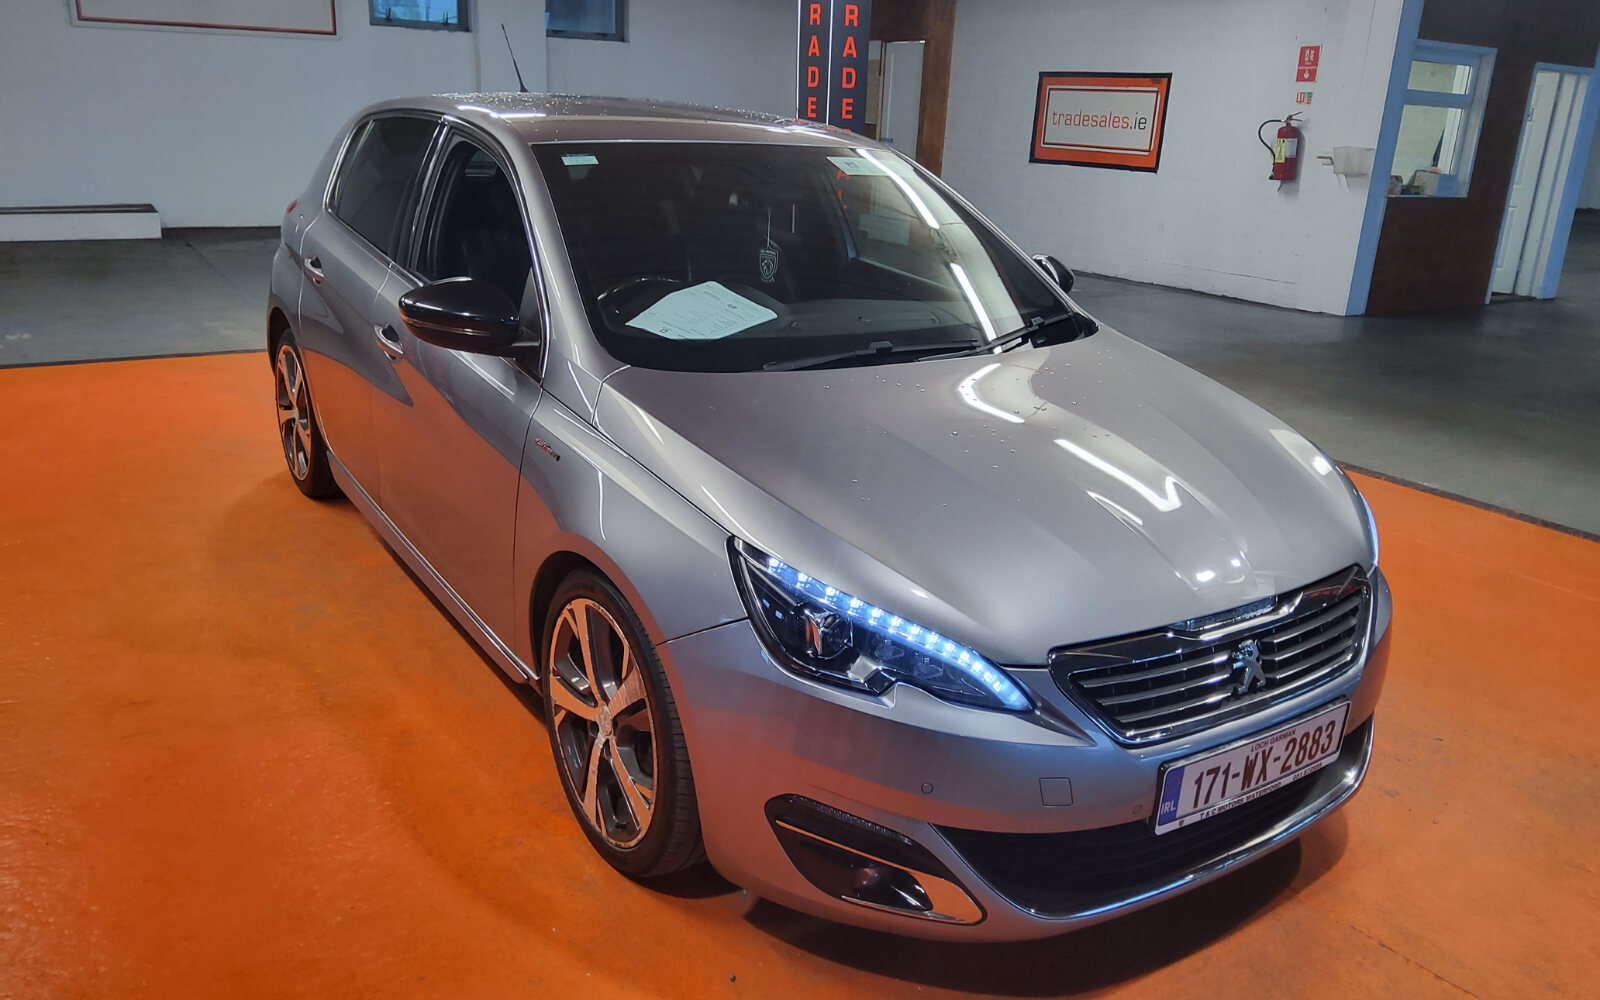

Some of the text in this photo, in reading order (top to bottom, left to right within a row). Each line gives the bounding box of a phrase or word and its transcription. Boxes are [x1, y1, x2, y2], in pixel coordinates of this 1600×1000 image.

[841, 4, 859, 133] RADE
[1052, 110, 1147, 131] tradesales.ie
[1251, 728, 1297, 752] LOCH GARMAN
[1193, 719, 1336, 809] 171-WX-2883
[1160, 799, 1176, 815] IRL
[1218, 798, 1244, 813] MOTORS
[1246, 781, 1282, 802] WATERFORD
